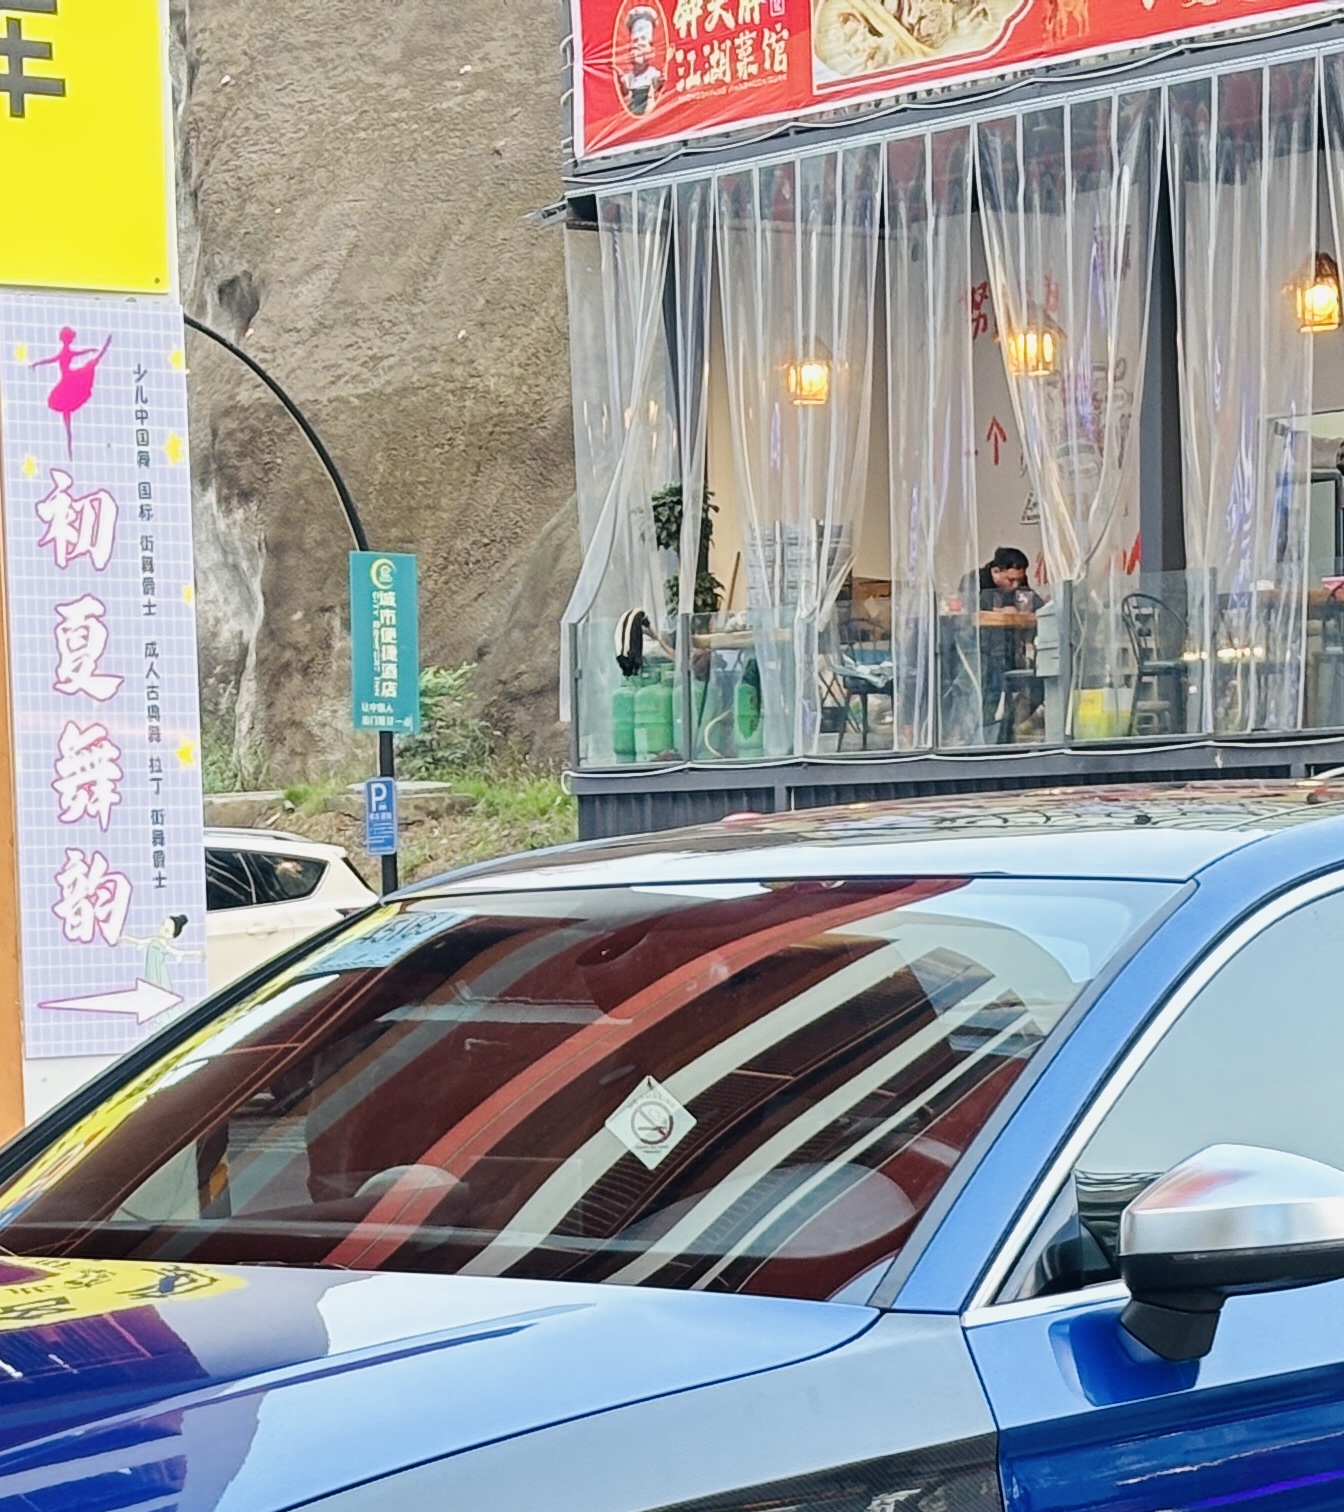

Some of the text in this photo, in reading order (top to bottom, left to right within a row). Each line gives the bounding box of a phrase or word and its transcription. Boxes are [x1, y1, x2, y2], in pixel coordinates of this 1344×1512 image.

[675, 23, 789, 92] 江湖菜馆
[35, 467, 133, 947] 初夏舞韵
[371, 783, 387, 812] P
